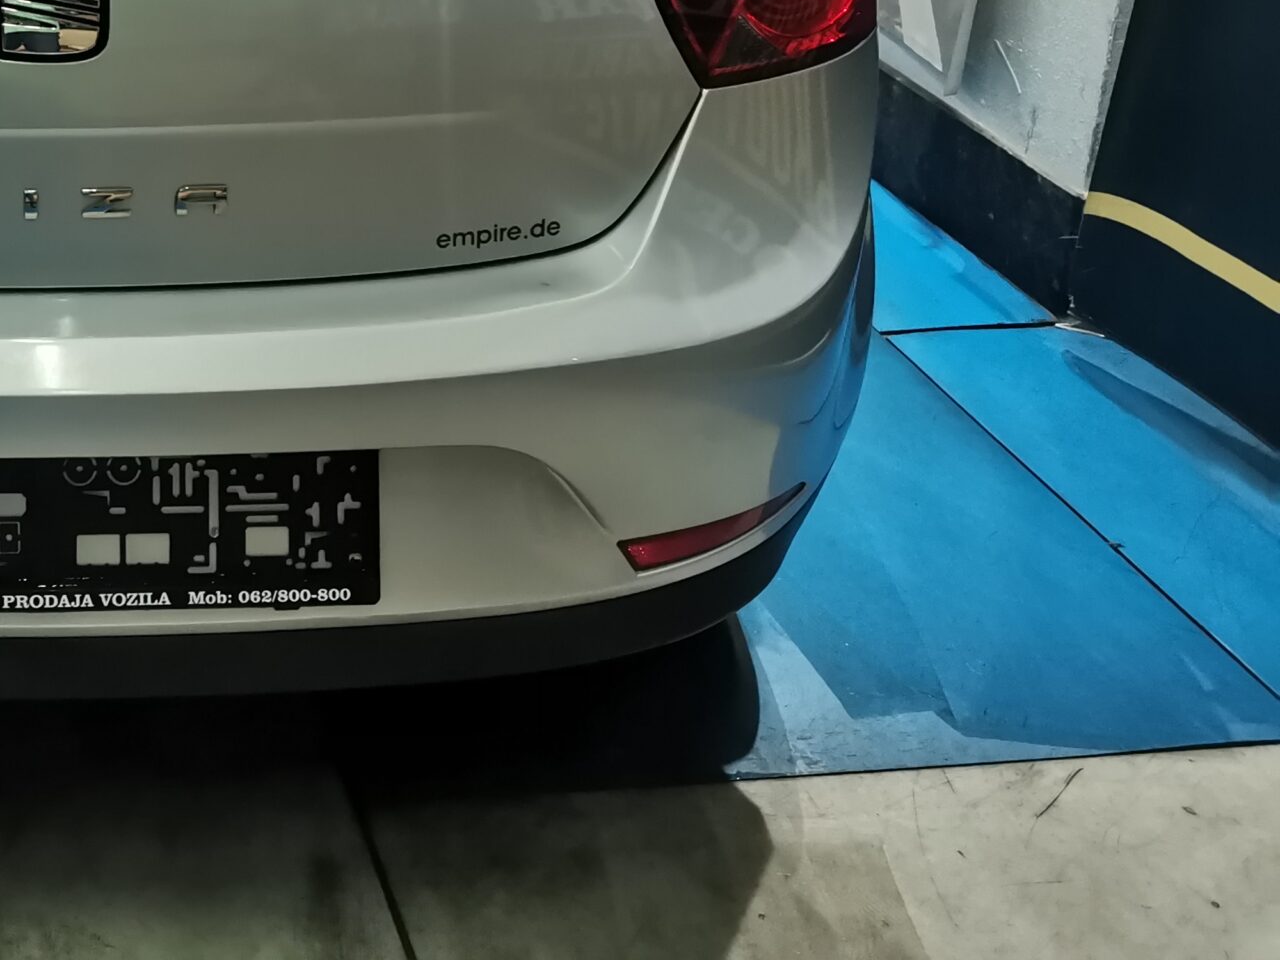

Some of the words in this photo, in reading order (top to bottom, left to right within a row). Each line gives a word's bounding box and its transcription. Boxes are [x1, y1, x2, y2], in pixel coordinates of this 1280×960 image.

[436, 218, 561, 249] empire.de
[1, 593, 95, 610] PRODAJA
[98, 591, 172, 607] VOZILA
[187, 590, 233, 606] Mob:
[237, 588, 352, 605] 062/800-800
